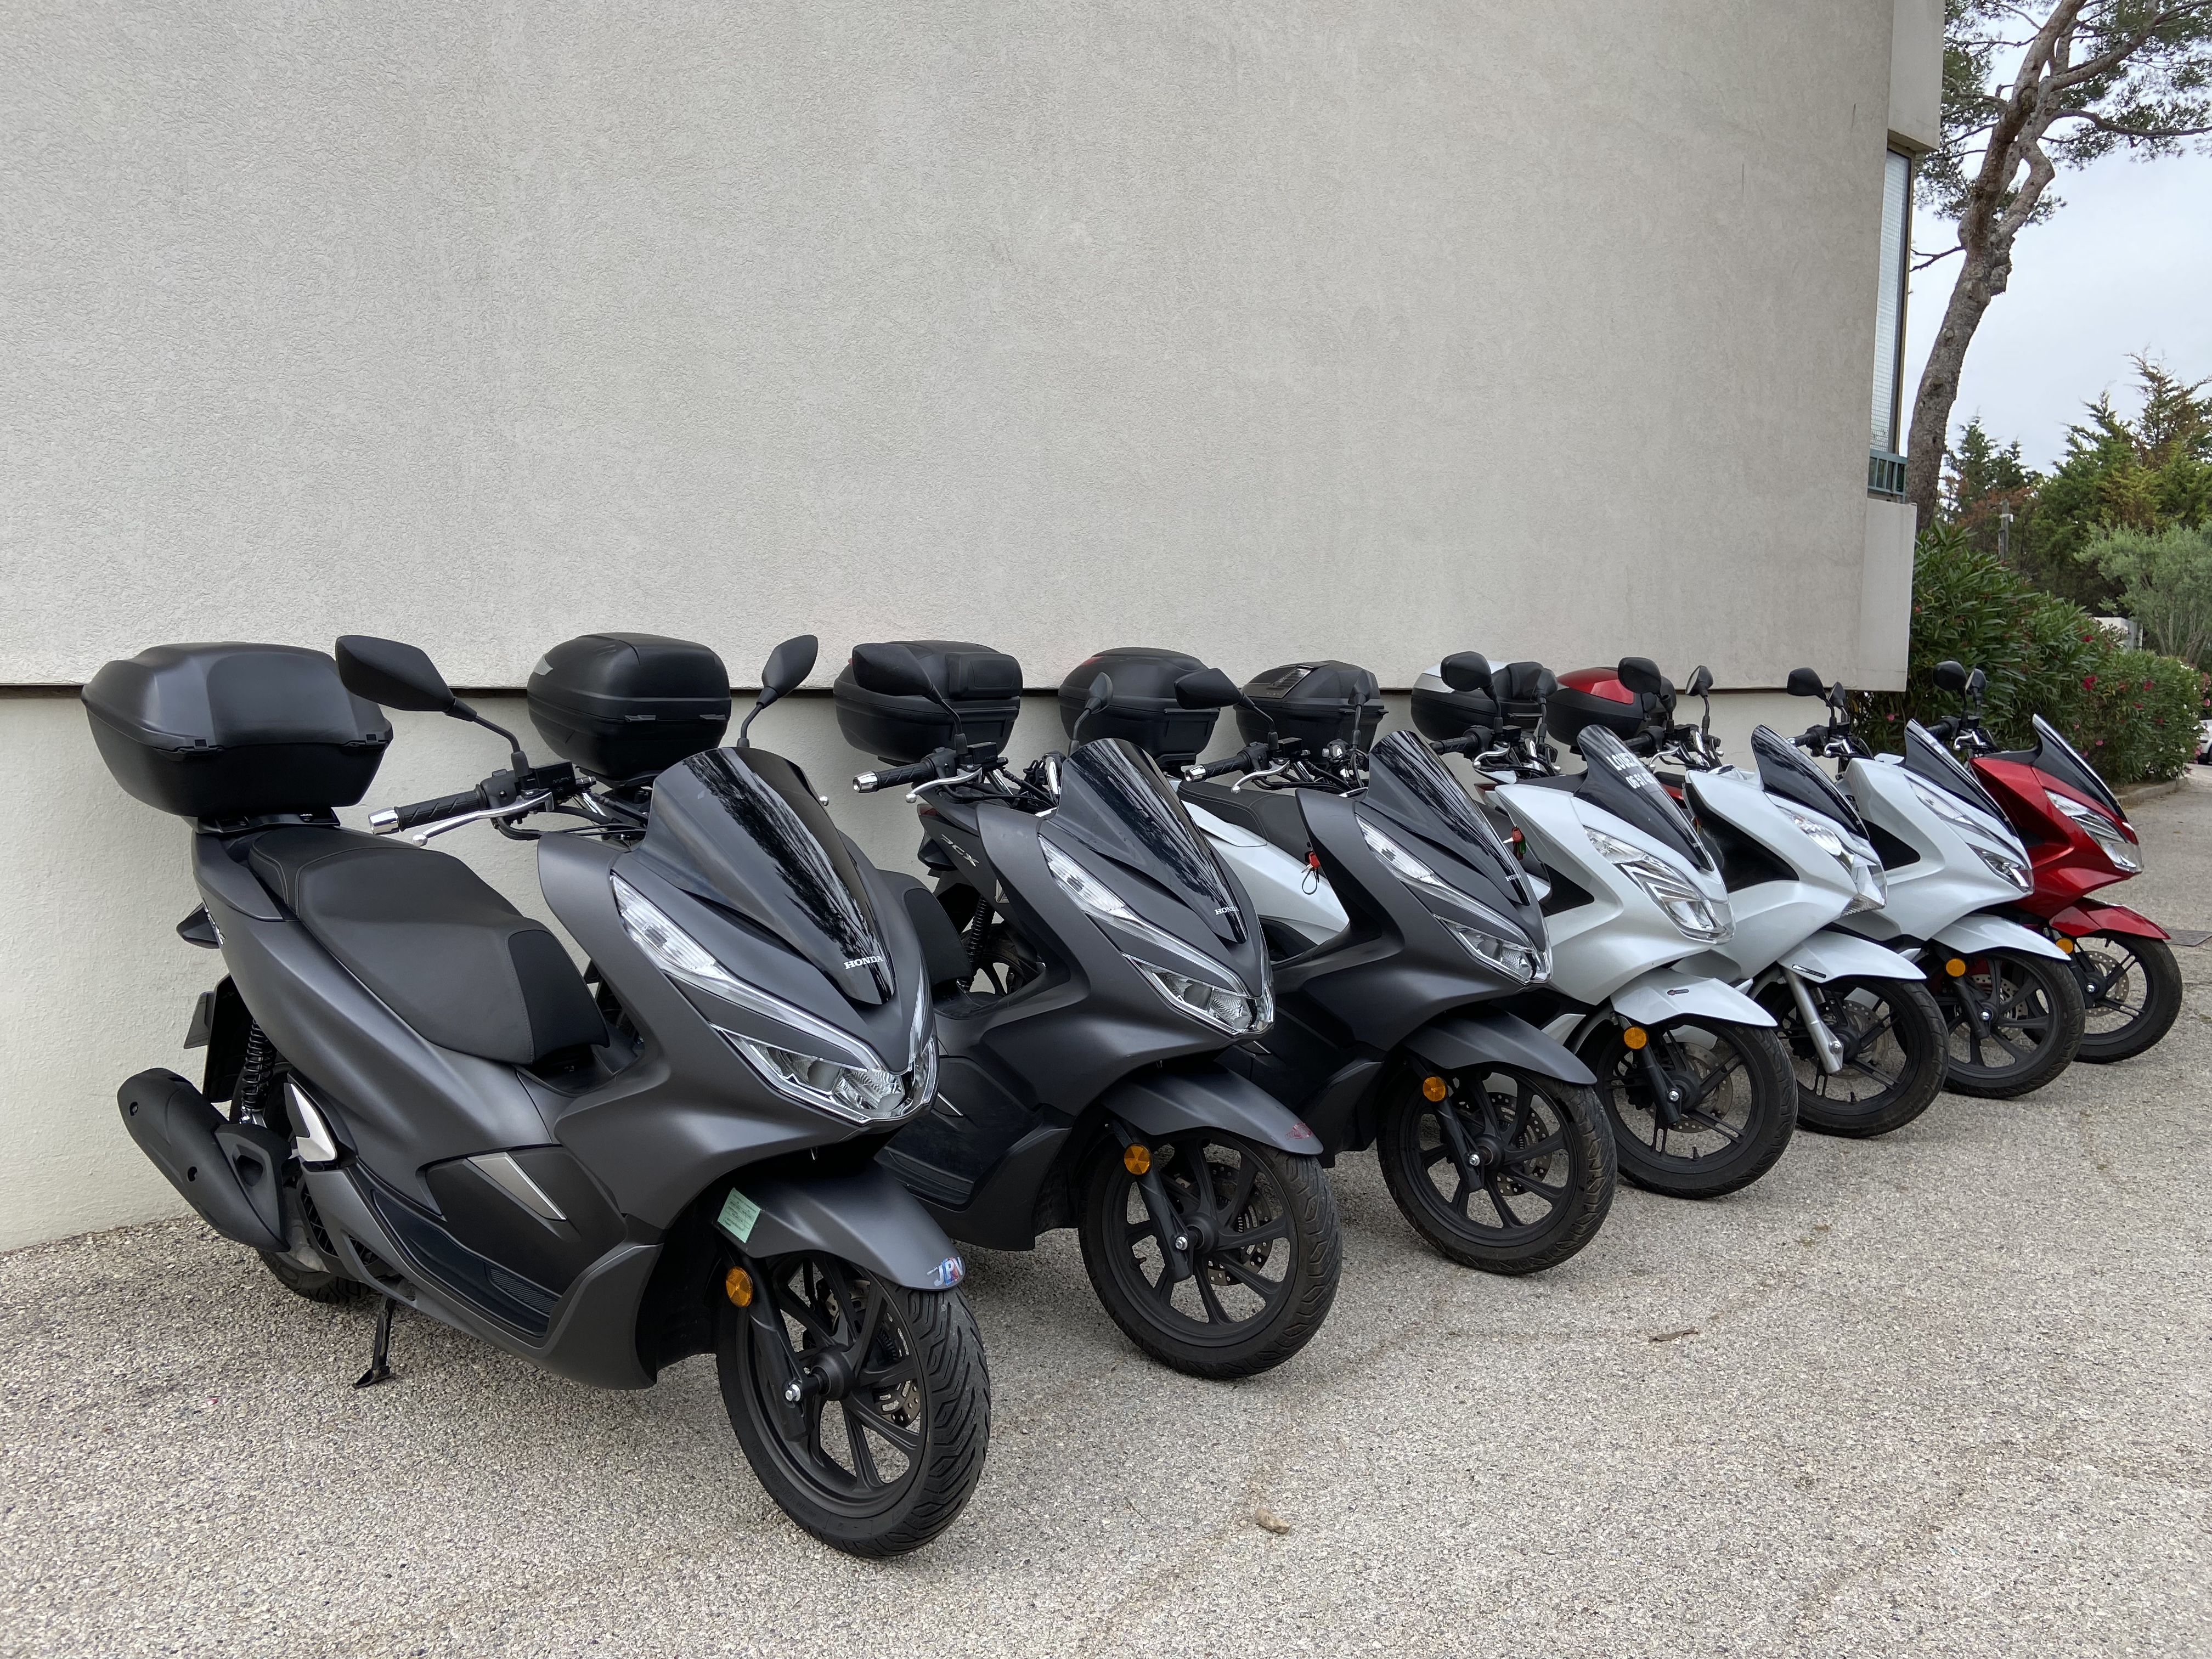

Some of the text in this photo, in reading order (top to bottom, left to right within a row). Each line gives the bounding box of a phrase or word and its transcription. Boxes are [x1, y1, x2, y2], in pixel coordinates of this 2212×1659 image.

[1625, 774, 1640, 789] 06
[941, 833, 979, 867] PCX
[843, 955, 884, 969] HONDA
[927, 1256, 963, 1286] JPV
